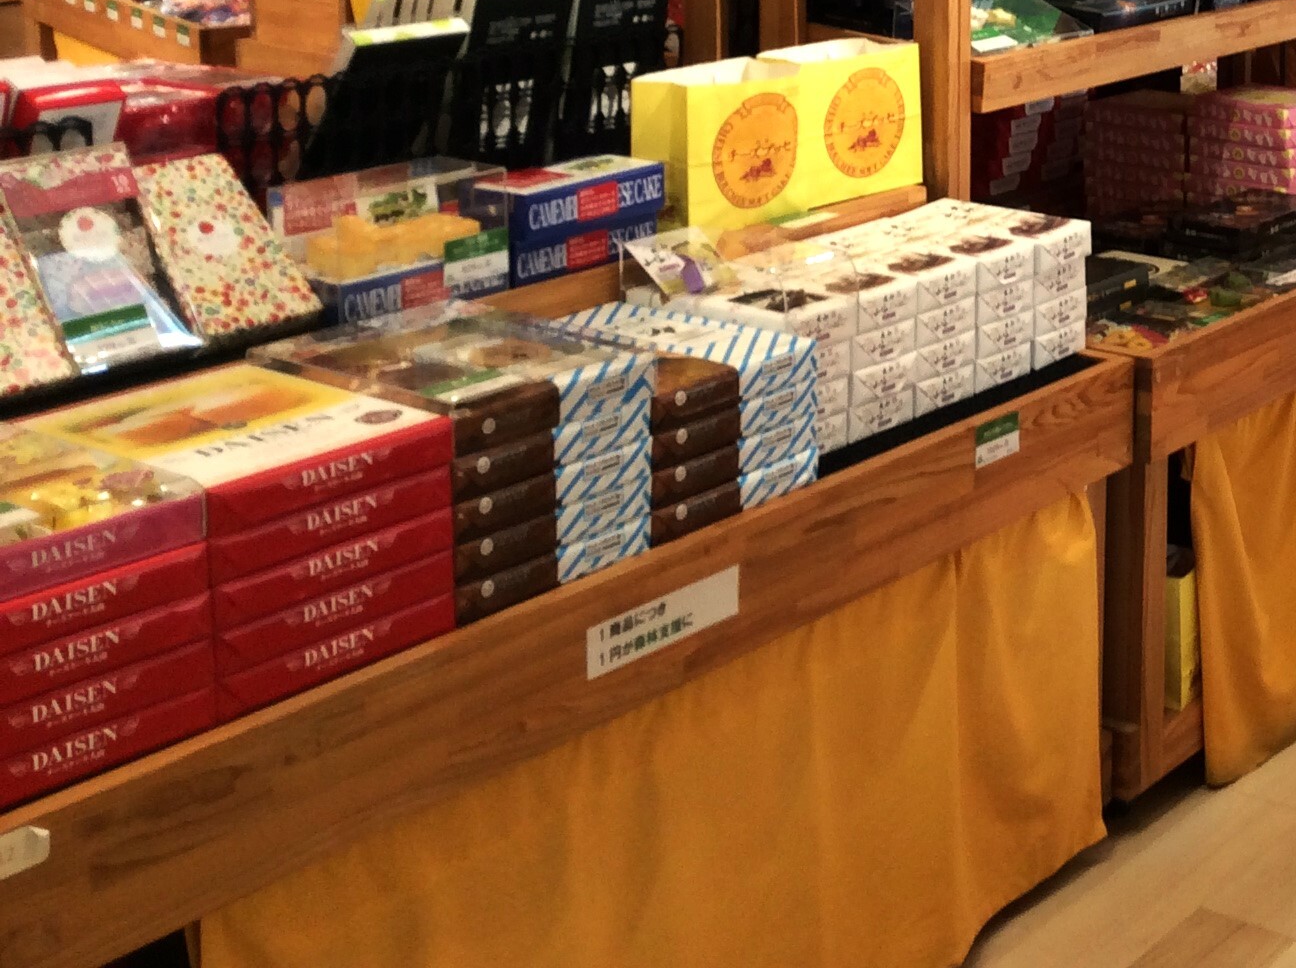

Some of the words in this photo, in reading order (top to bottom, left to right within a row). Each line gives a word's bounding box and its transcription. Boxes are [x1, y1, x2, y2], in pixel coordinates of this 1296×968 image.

[301, 451, 374, 488] DAISEN
[306, 494, 379, 532] DAISEN
[31, 527, 118, 569] DAISEN
[308, 536, 379, 577] DAISEN
[31, 578, 120, 622] DAISEN
[303, 582, 374, 624] DAISEN
[34, 626, 120, 672] DAISEN
[304, 627, 375, 668] DAISEN
[31, 677, 118, 724] DAISEN
[32, 724, 118, 772] DAISEN
